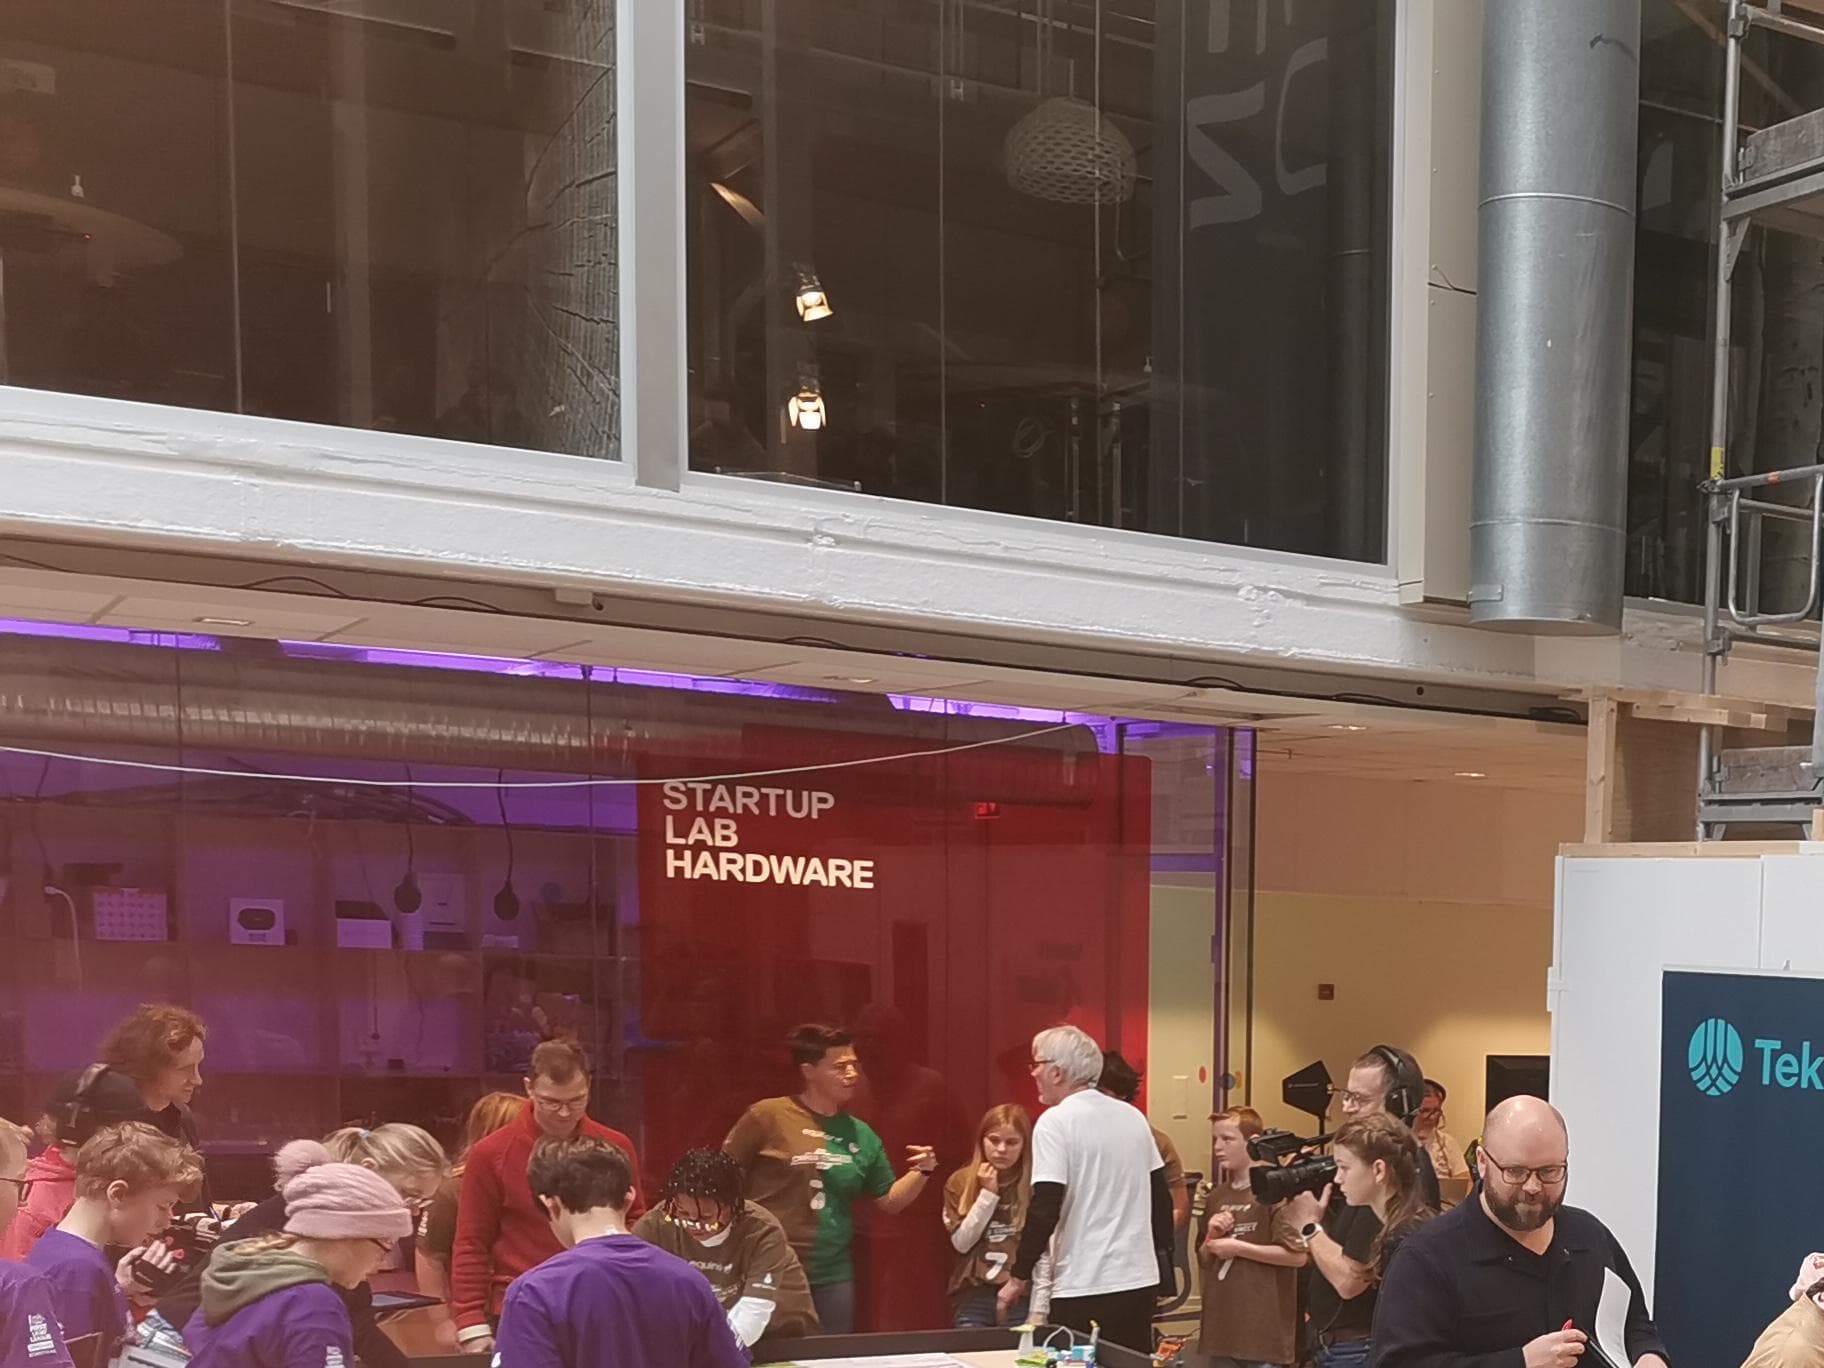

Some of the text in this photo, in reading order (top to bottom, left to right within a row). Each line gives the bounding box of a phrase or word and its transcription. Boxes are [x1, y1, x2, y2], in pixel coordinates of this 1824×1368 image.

[662, 781, 836, 820] STARTUP
[665, 814, 739, 848] LAB
[665, 848, 875, 889] HARDWARE
[985, 1252, 1008, 1280] 7
